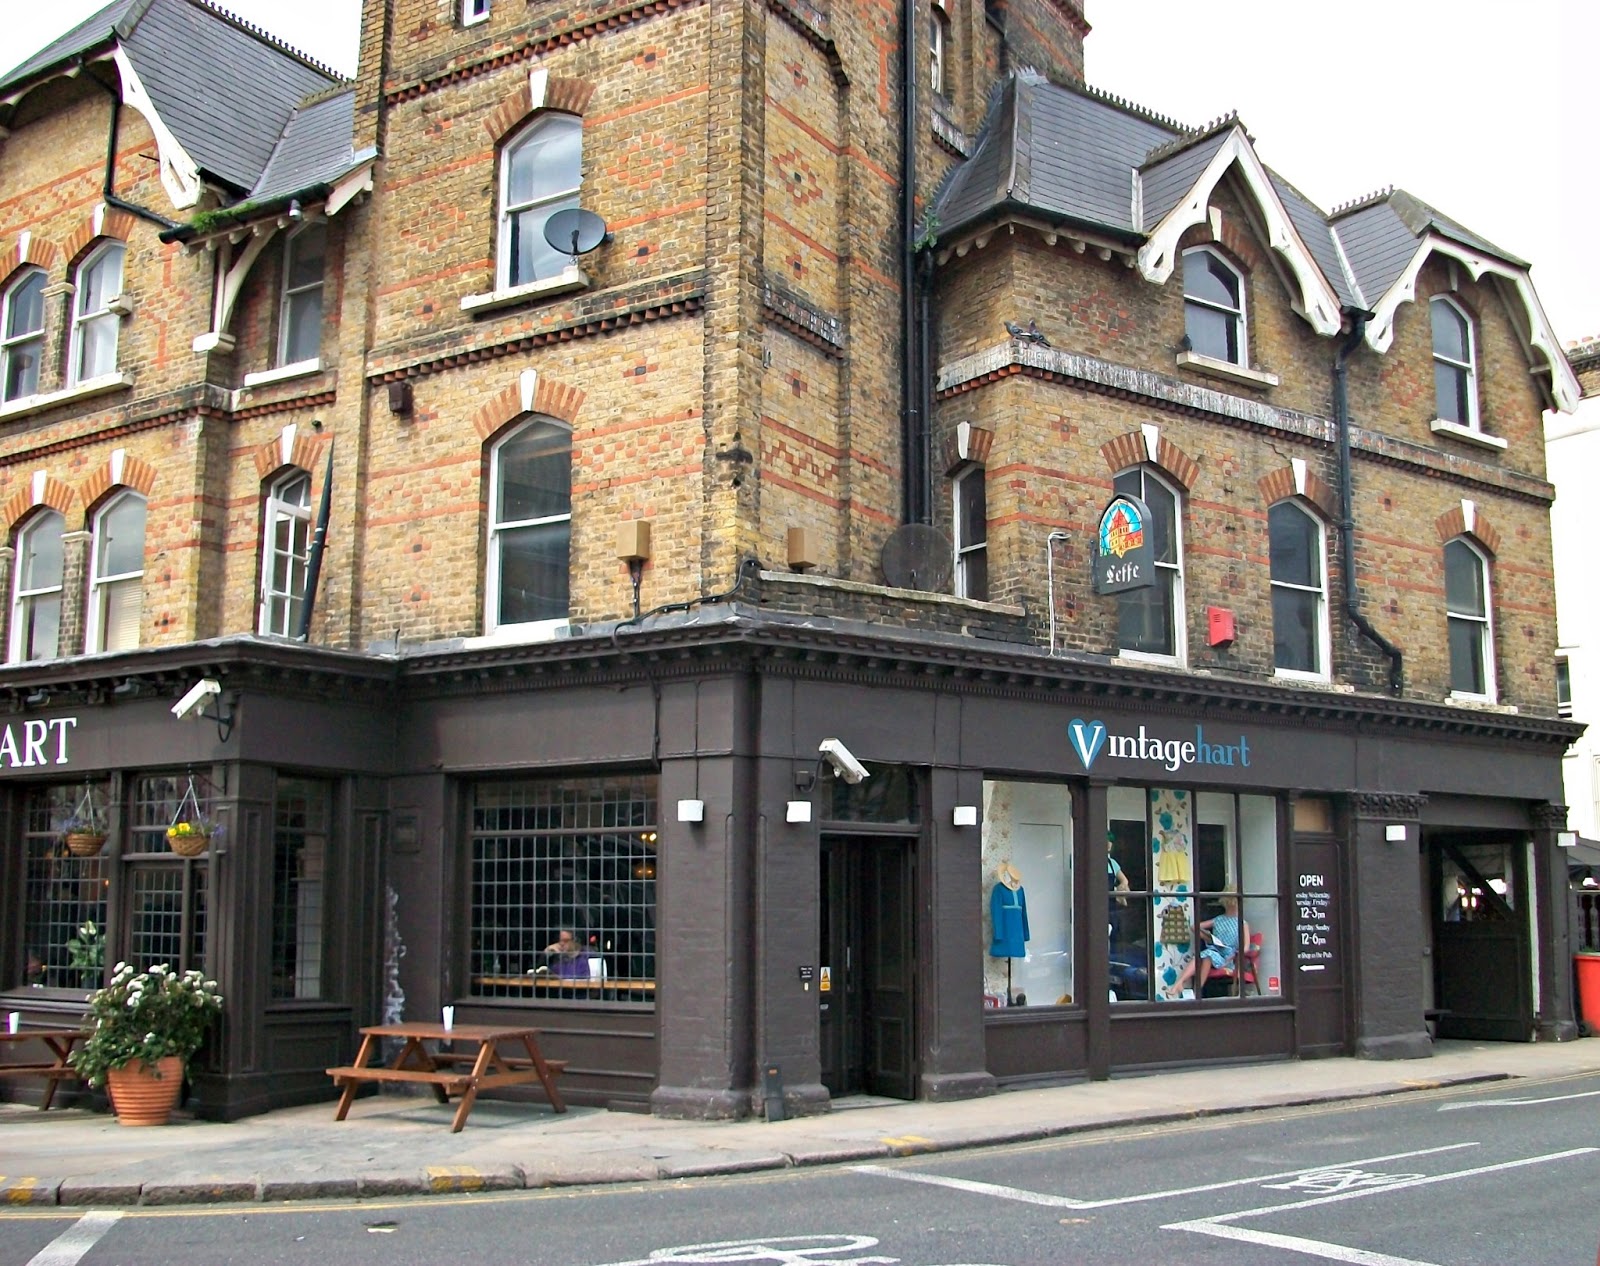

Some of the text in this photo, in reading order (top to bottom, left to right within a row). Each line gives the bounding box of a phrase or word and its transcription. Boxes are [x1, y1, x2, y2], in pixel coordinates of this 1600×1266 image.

[1106, 562, 1140, 584] Leffe
[0, 717, 77, 768] ART
[1300, 875, 1323, 887] OPEN
